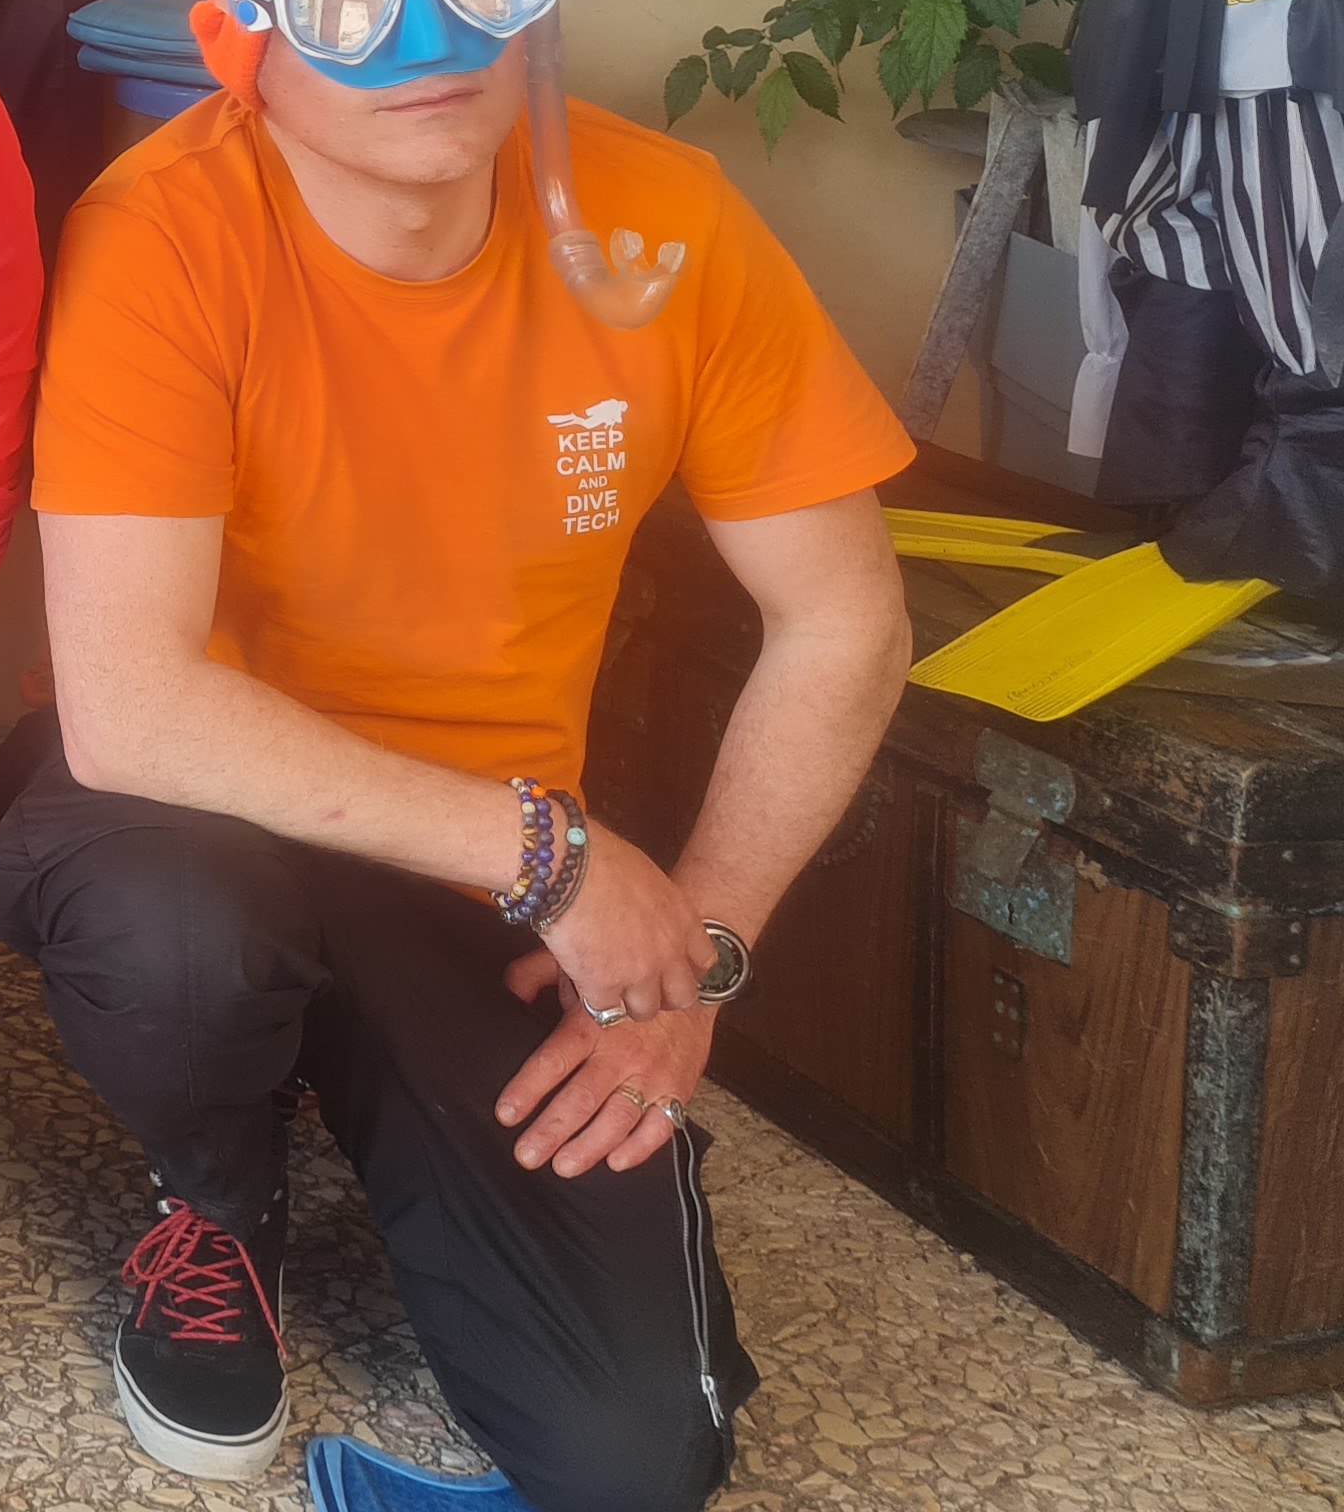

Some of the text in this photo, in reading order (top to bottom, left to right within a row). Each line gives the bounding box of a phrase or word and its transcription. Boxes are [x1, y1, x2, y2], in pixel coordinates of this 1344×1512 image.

[558, 430, 624, 453] KEEP
[556, 451, 626, 476] CALM
[578, 475, 608, 490] AND
[566, 490, 617, 515] DIVE
[562, 509, 619, 535] TECH
